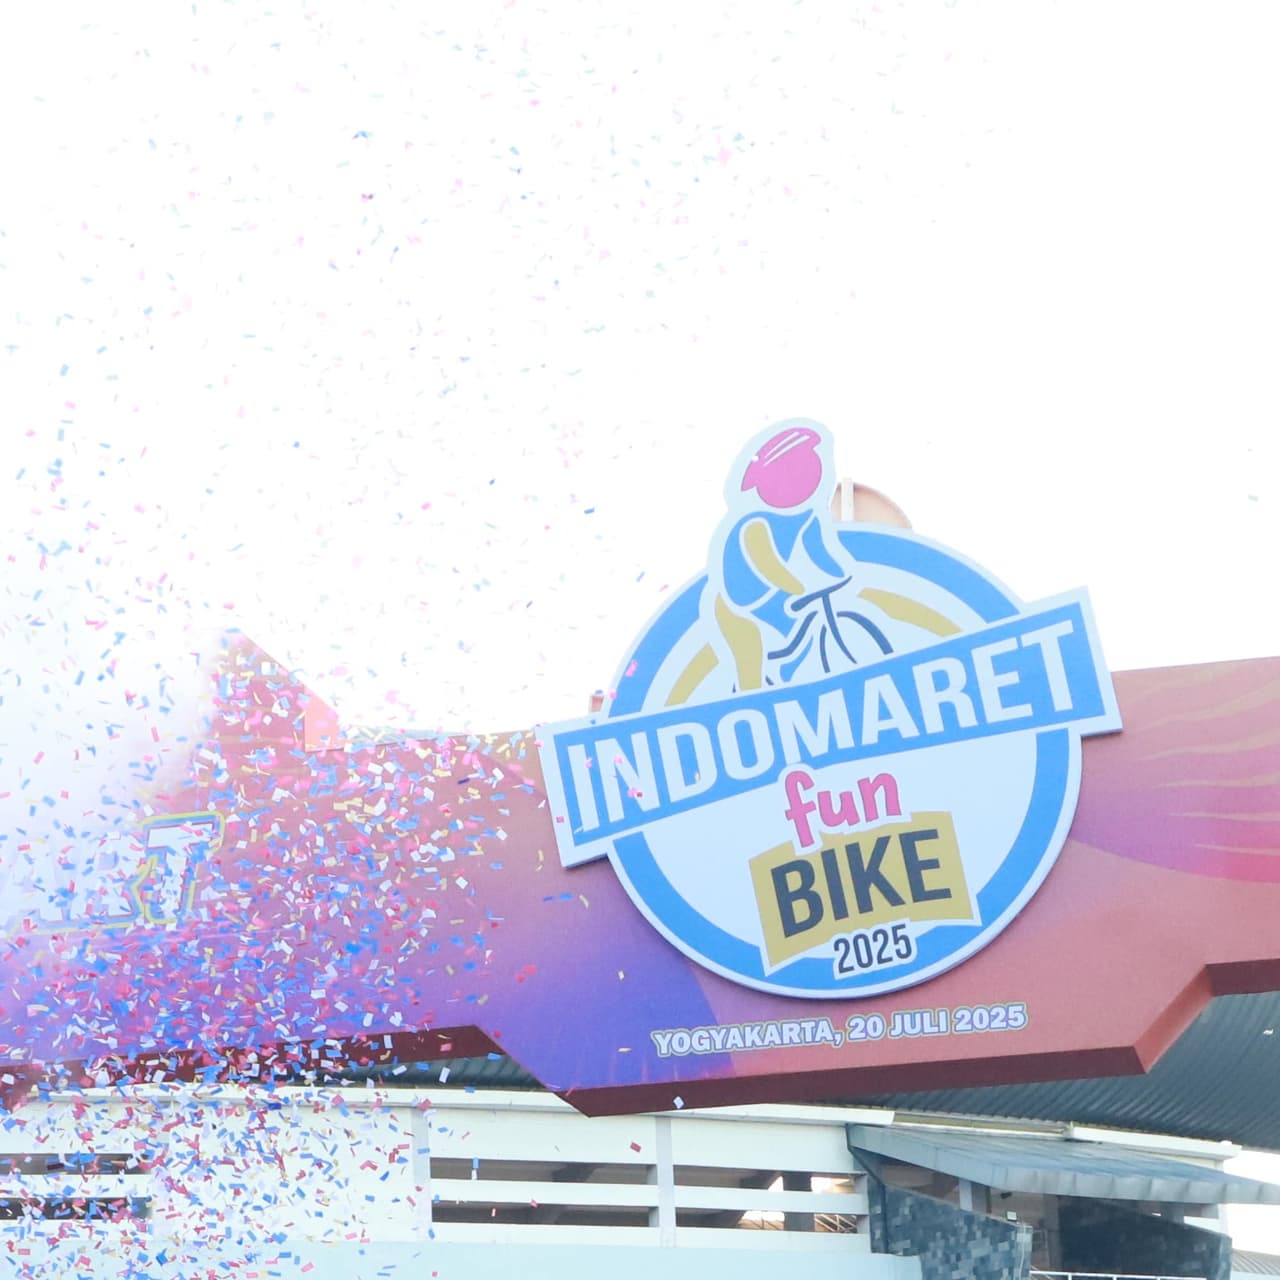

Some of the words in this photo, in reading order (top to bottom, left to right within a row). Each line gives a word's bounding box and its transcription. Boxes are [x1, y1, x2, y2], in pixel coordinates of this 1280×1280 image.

[567, 620, 1076, 833] INDOMARET
[785, 771, 900, 847] fun
[771, 829, 951, 938] BIKE
[834, 924, 912, 974] 2025
[654, 1018, 842, 1056] YOGYAKARTA,
[848, 1015, 885, 1040] 20
[890, 1009, 948, 1036] JULI
[954, 1004, 1027, 1031] 2025
